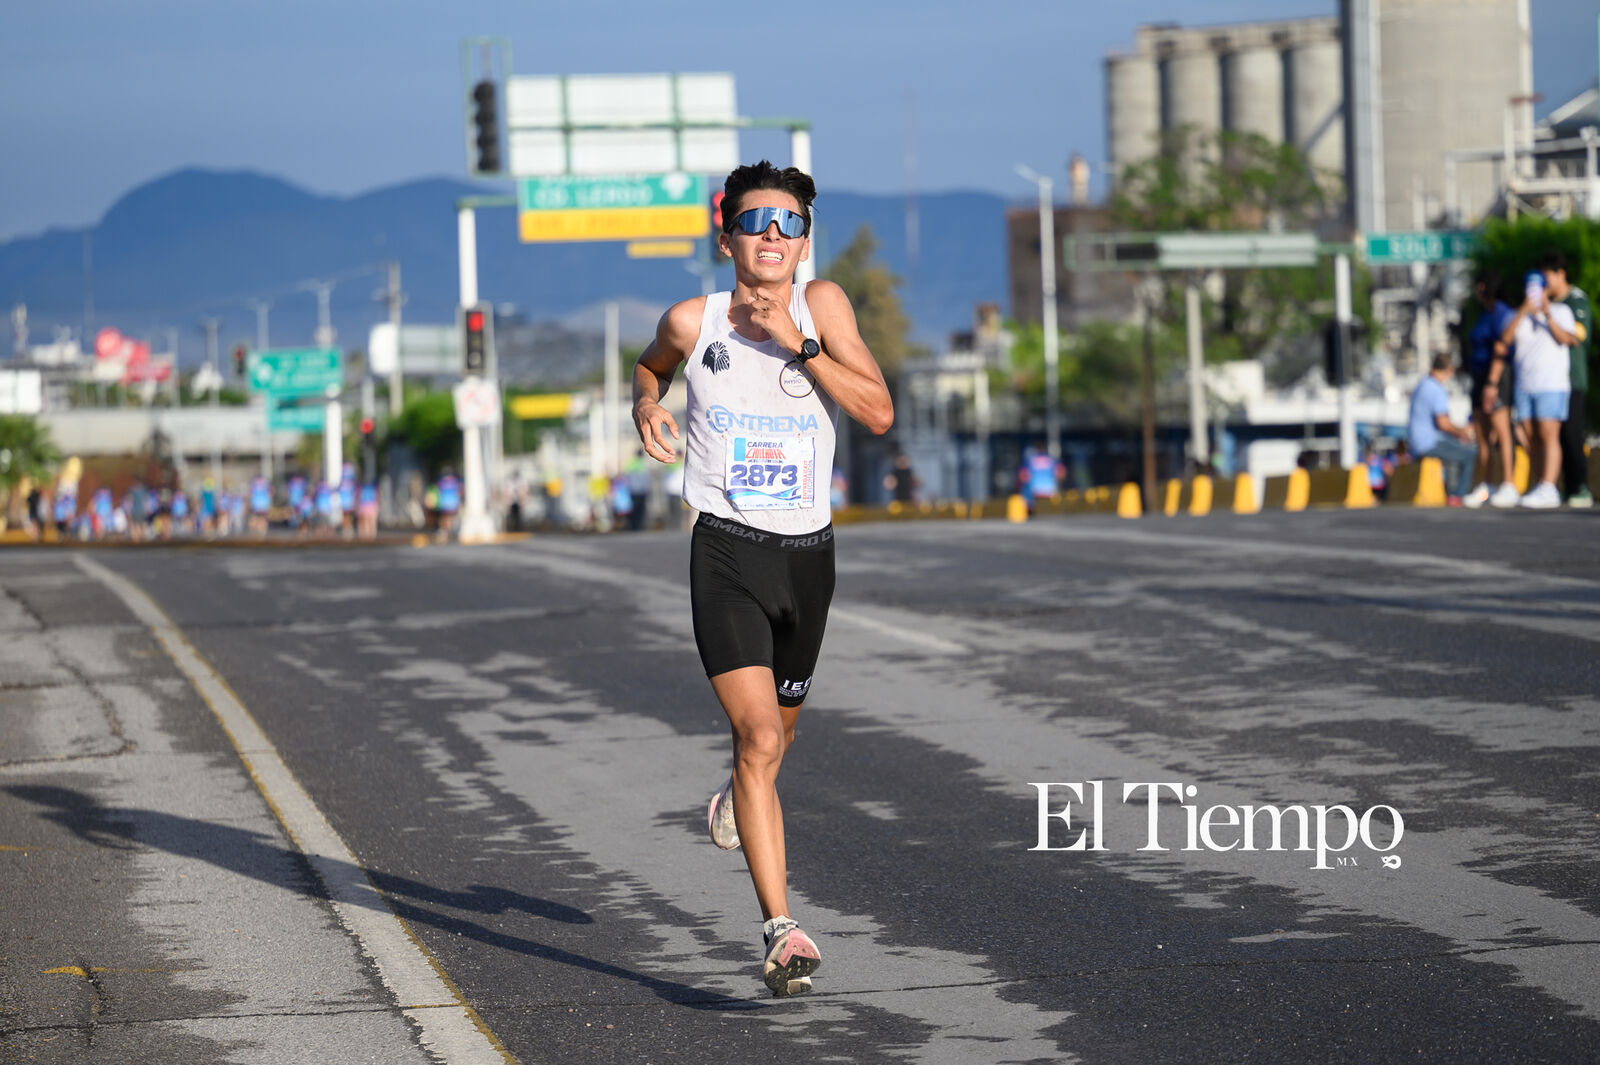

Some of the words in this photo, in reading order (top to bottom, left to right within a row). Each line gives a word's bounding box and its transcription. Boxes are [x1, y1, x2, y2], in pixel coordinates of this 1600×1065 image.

[708, 406, 818, 432] ENTRENA
[730, 464, 798, 487] 2873
[780, 536, 819, 547] PRO
